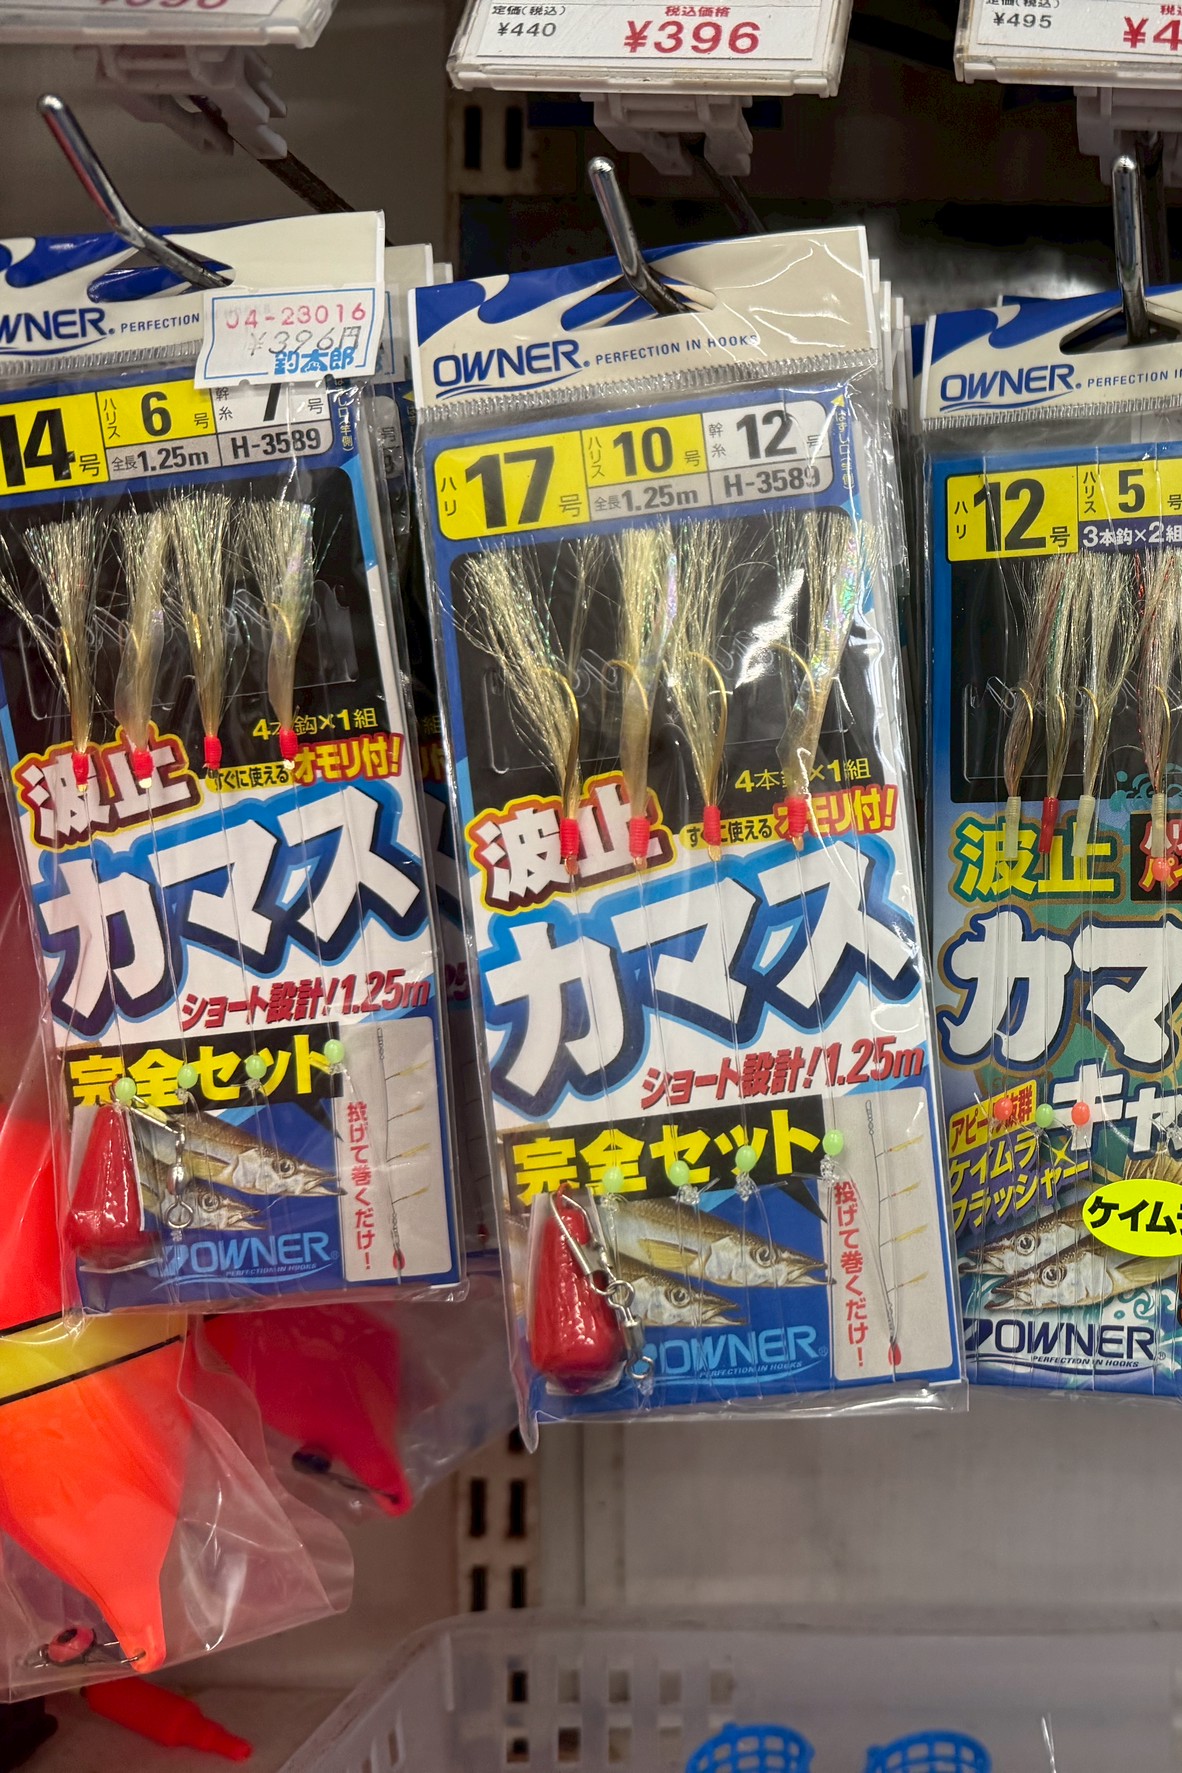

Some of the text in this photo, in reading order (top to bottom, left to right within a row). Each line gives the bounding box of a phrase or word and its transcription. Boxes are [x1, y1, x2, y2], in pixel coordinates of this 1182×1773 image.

[492, 5, 567, 16] 定価(税込)
[497, 22, 558, 38] ¥440
[665, 6, 731, 18] 税込価格
[992, 12, 1053, 29] ¥495
[624, 20, 761, 54] ¥396
[120, 313, 200, 334] PERFECTION
[273, 347, 356, 376] 釣太郎
[433, 333, 759, 388] OWNER PERFECTION IN HOOKS
[939, 364, 1076, 402] OWNER
[1087, 374, 1171, 389] PERFECTION
[102, 396, 121, 441] ハリス
[231, 428, 322, 460] H-3589
[587, 436, 605, 479] ハリス
[439, 476, 458, 518] ハリ
[724, 465, 821, 499] H-3589
[1083, 470, 1097, 514] ハリス
[954, 501, 969, 540] ハリ
[293, 737, 400, 784] オモリ付!
[25, 745, 190, 840] 波止
[480, 785, 663, 902] 波止
[958, 822, 1115, 897] 波止
[38, 786, 420, 1020] カマス
[486, 842, 912, 1096] カマス
[68, 1034, 332, 1109] 完全セット
[513, 1109, 821, 1206] 完全セット
[346, 1101, 373, 1270] 投げて巻くだけ!
[190, 1232, 332, 1273] OWNER
[834, 1181, 869, 1367] 投げて巻くだけ!
[657, 1326, 818, 1370] OWNER
[995, 1320, 1157, 1361] OWNER
[1106, 1358, 1139, 1368] HOOKS
